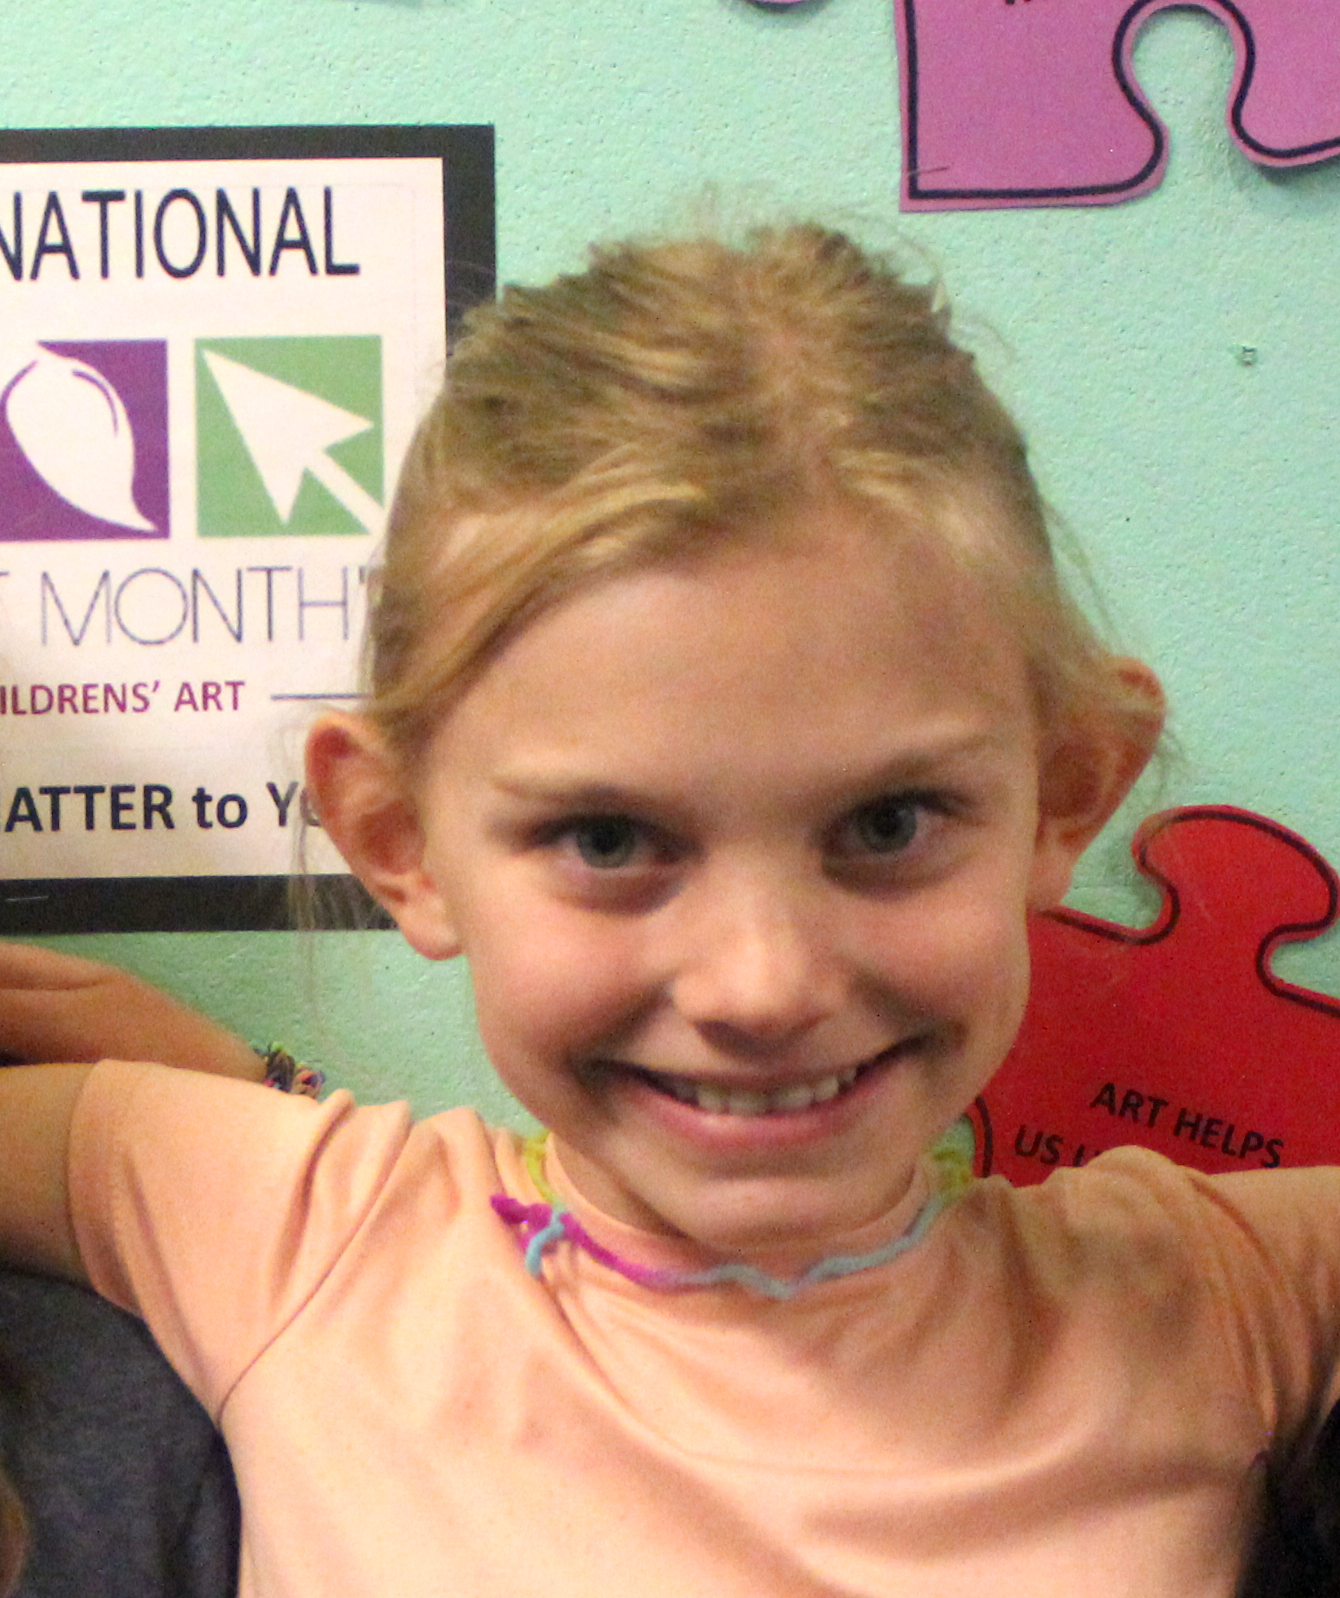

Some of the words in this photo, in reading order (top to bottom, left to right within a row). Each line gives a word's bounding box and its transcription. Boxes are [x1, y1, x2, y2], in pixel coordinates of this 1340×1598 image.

[174, 680, 245, 712] ART
[191, 787, 248, 830] to
[1014, 1123, 1064, 1165] US
[1090, 1082, 1169, 1128] ART
[1173, 1107, 1284, 1168] HELPS
